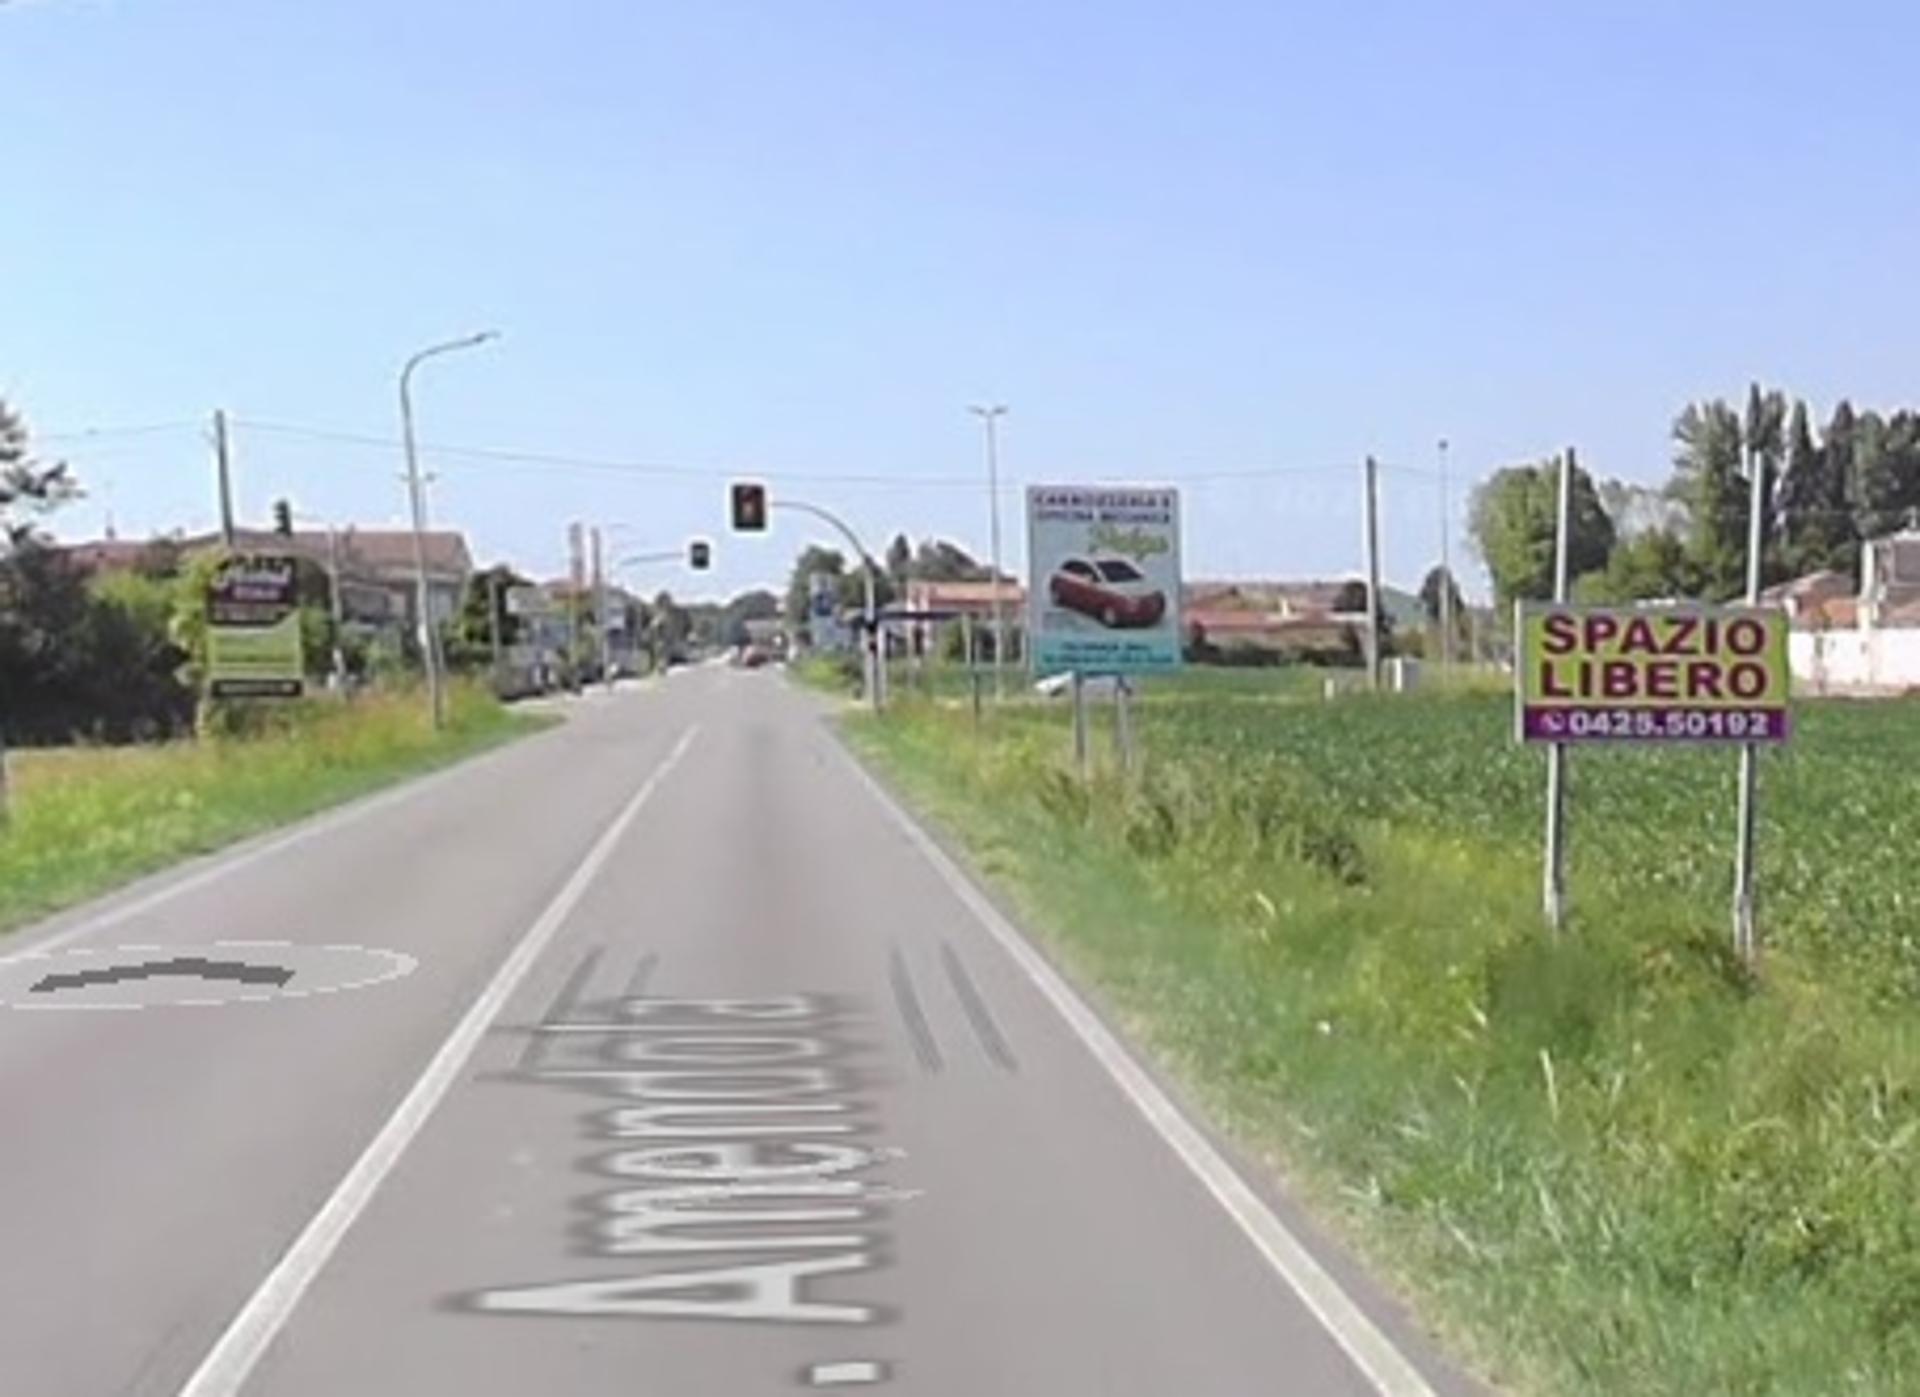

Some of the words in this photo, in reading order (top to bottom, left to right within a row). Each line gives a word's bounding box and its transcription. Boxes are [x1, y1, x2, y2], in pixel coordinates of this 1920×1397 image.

[1541, 613, 1767, 656] SPAZIO
[1540, 660, 1768, 699] LIBERO
[1569, 710, 1769, 736] 0425.50192
